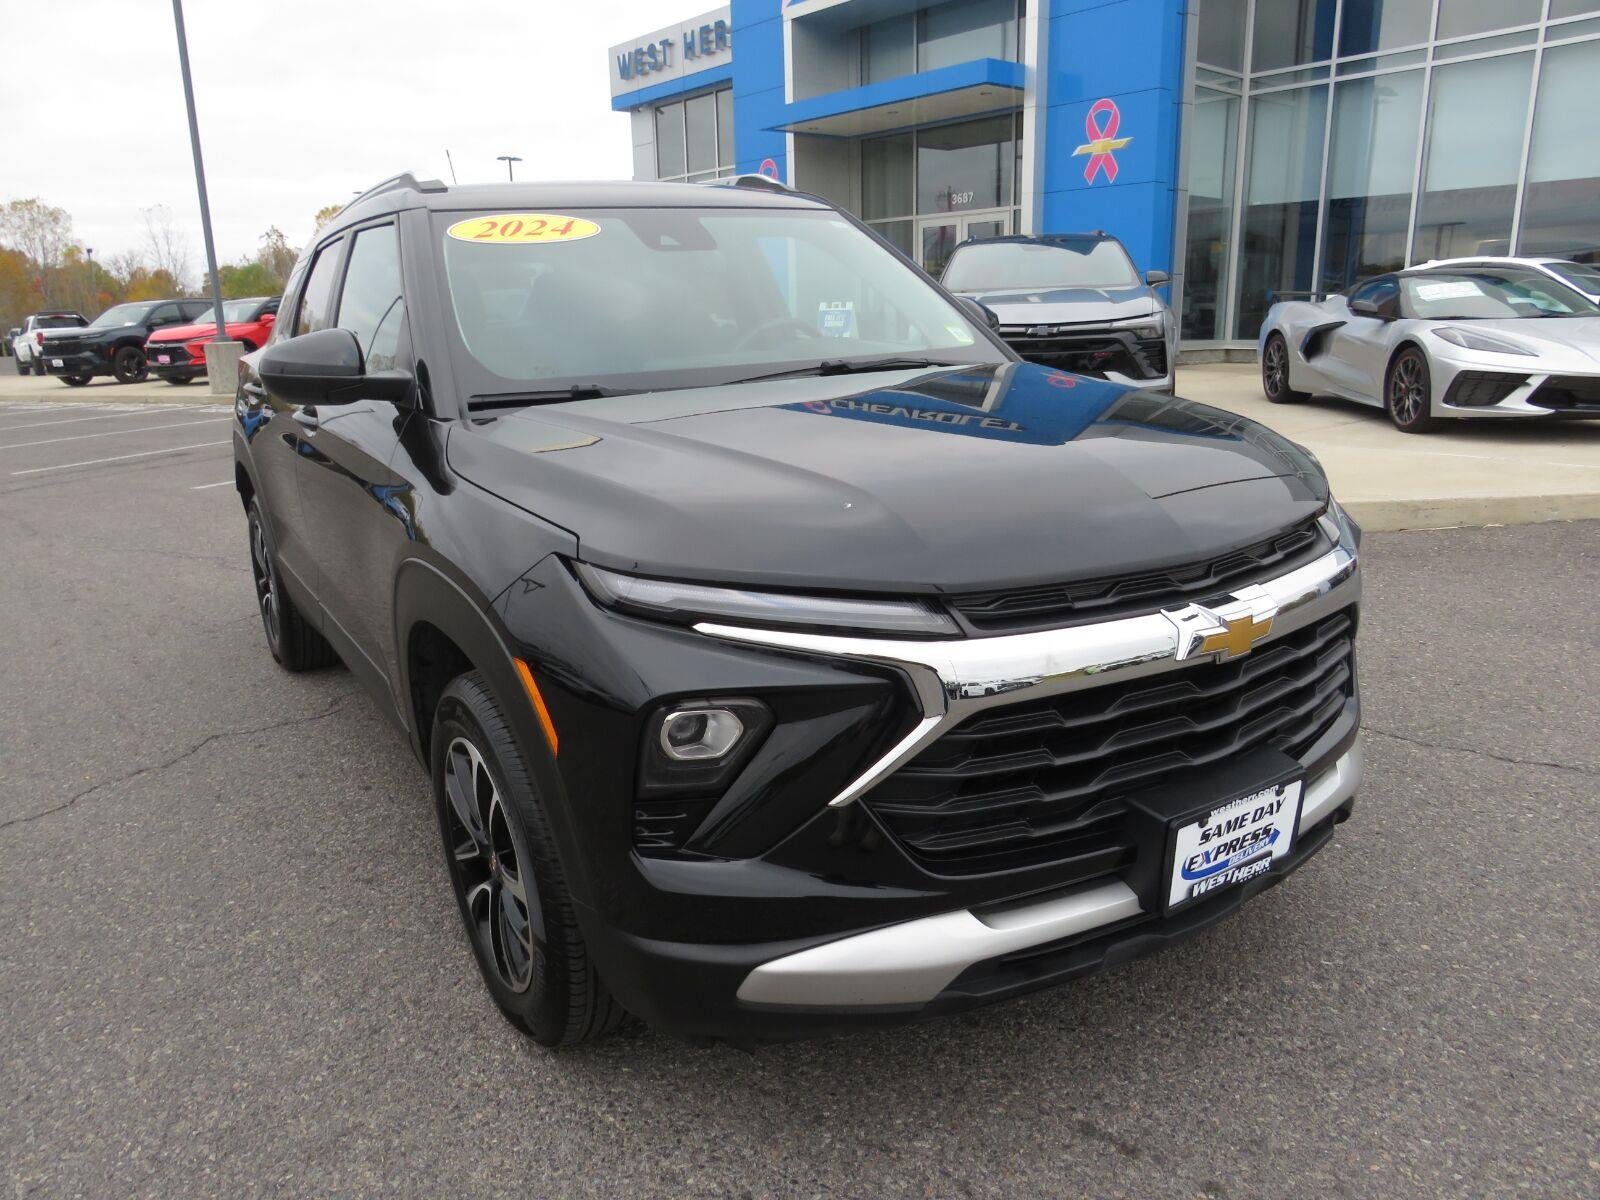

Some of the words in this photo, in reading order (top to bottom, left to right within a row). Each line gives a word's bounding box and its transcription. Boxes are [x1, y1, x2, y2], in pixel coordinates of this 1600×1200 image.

[616, 38, 674, 81] WEST
[951, 191, 974, 205] 3687
[474, 219, 575, 239] 2024
[1199, 811, 1250, 846] SAME
[1250, 796, 1286, 824] DAY
[1187, 822, 1274, 872] EXPRESS
